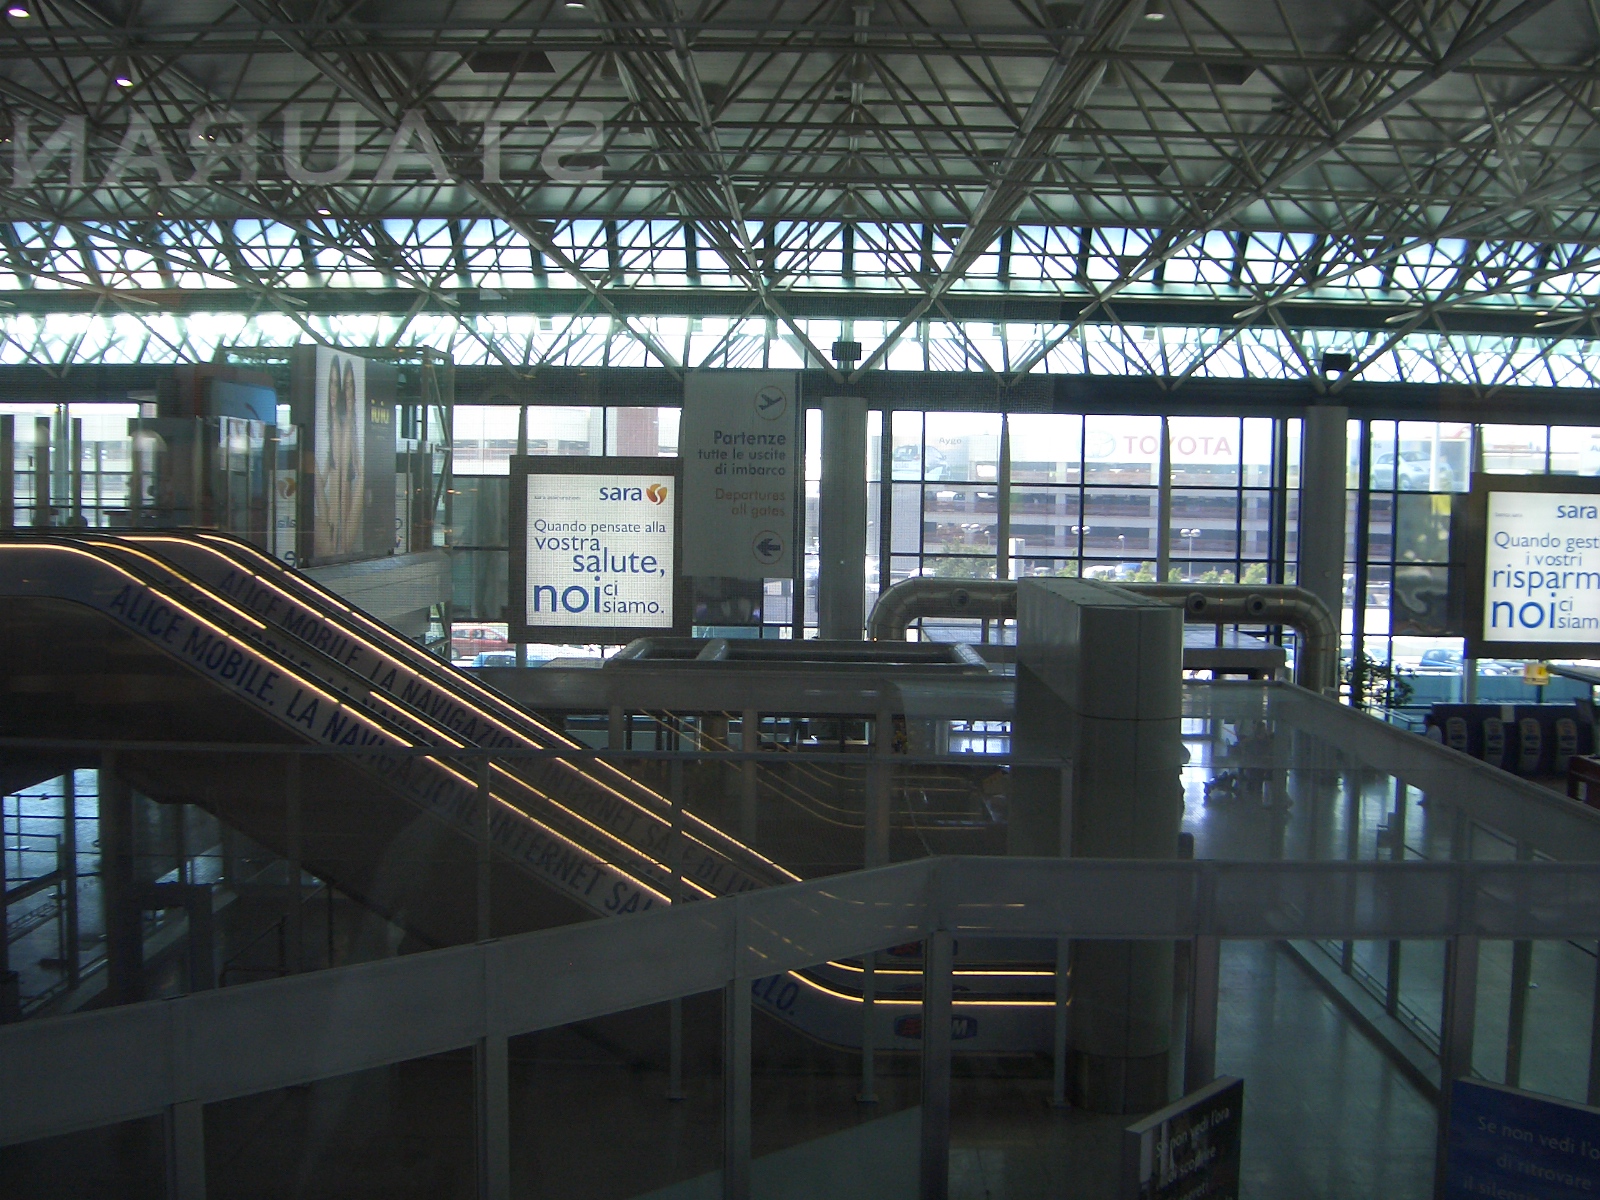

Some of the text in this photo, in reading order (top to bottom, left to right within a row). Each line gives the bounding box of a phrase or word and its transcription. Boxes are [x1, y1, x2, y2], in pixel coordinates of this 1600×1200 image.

[714, 430, 786, 446] Partenze
[939, 437, 962, 447] Aygo
[1123, 435, 1233, 456] TOOTA
[698, 448, 786, 461] tutte le uscite
[715, 463, 786, 476] di imbarco
[599, 486, 643, 502] sara
[715, 488, 786, 503] Departures
[731, 504, 786, 519] all gates
[1557, 504, 1598, 519] sara
[534, 519, 666, 535] Quando pensate alla
[534, 536, 600, 551] vostra
[1494, 531, 1562, 549] Quando
[572, 547, 666, 578] salute,
[1525, 551, 1583, 567] i vostri
[1492, 564, 1600, 598] risparm
[533, 576, 618, 613] noi ci
[603, 597, 665, 614] siamo.
[1491, 592, 1573, 629] noi ci
[110, 585, 184, 643] ALICE
[182, 629, 281, 707] MOBILE.
[286, 687, 318, 730] LA
[489, 813, 607, 895] INTERNET
[1478, 1116, 1497, 1134] Se
[1502, 1125, 1534, 1142] non
[1539, 1133, 1576, 1154] vedi
[1497, 1152, 1592, 1191] di ritrovare
